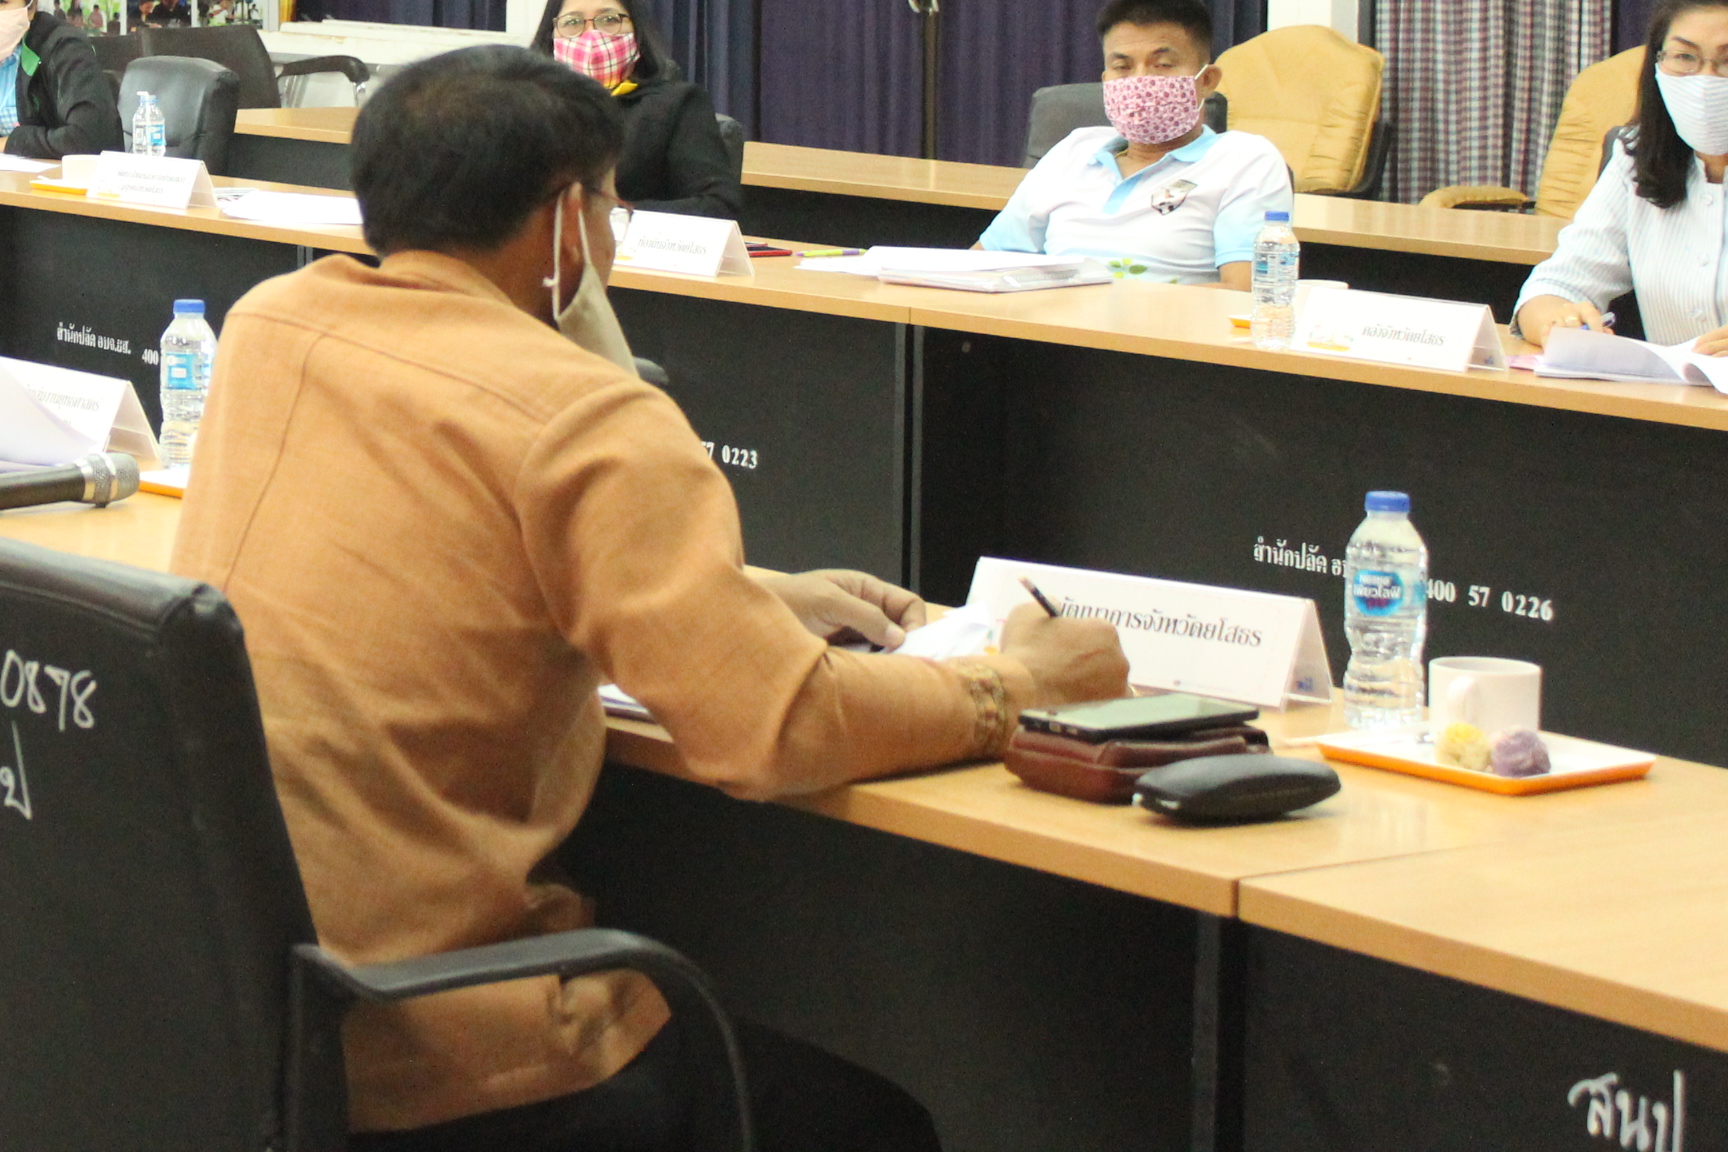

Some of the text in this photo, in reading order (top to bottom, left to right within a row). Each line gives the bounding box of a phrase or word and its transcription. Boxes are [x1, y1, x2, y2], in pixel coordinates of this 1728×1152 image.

[141, 348, 160, 366] 400
[721, 444, 758, 470] 0223
[1253, 536, 1328, 574] สำนักปลัด
[1468, 585, 1491, 608] 57
[1501, 590, 1554, 622] 0226
[0, 649, 98, 732] 0878
